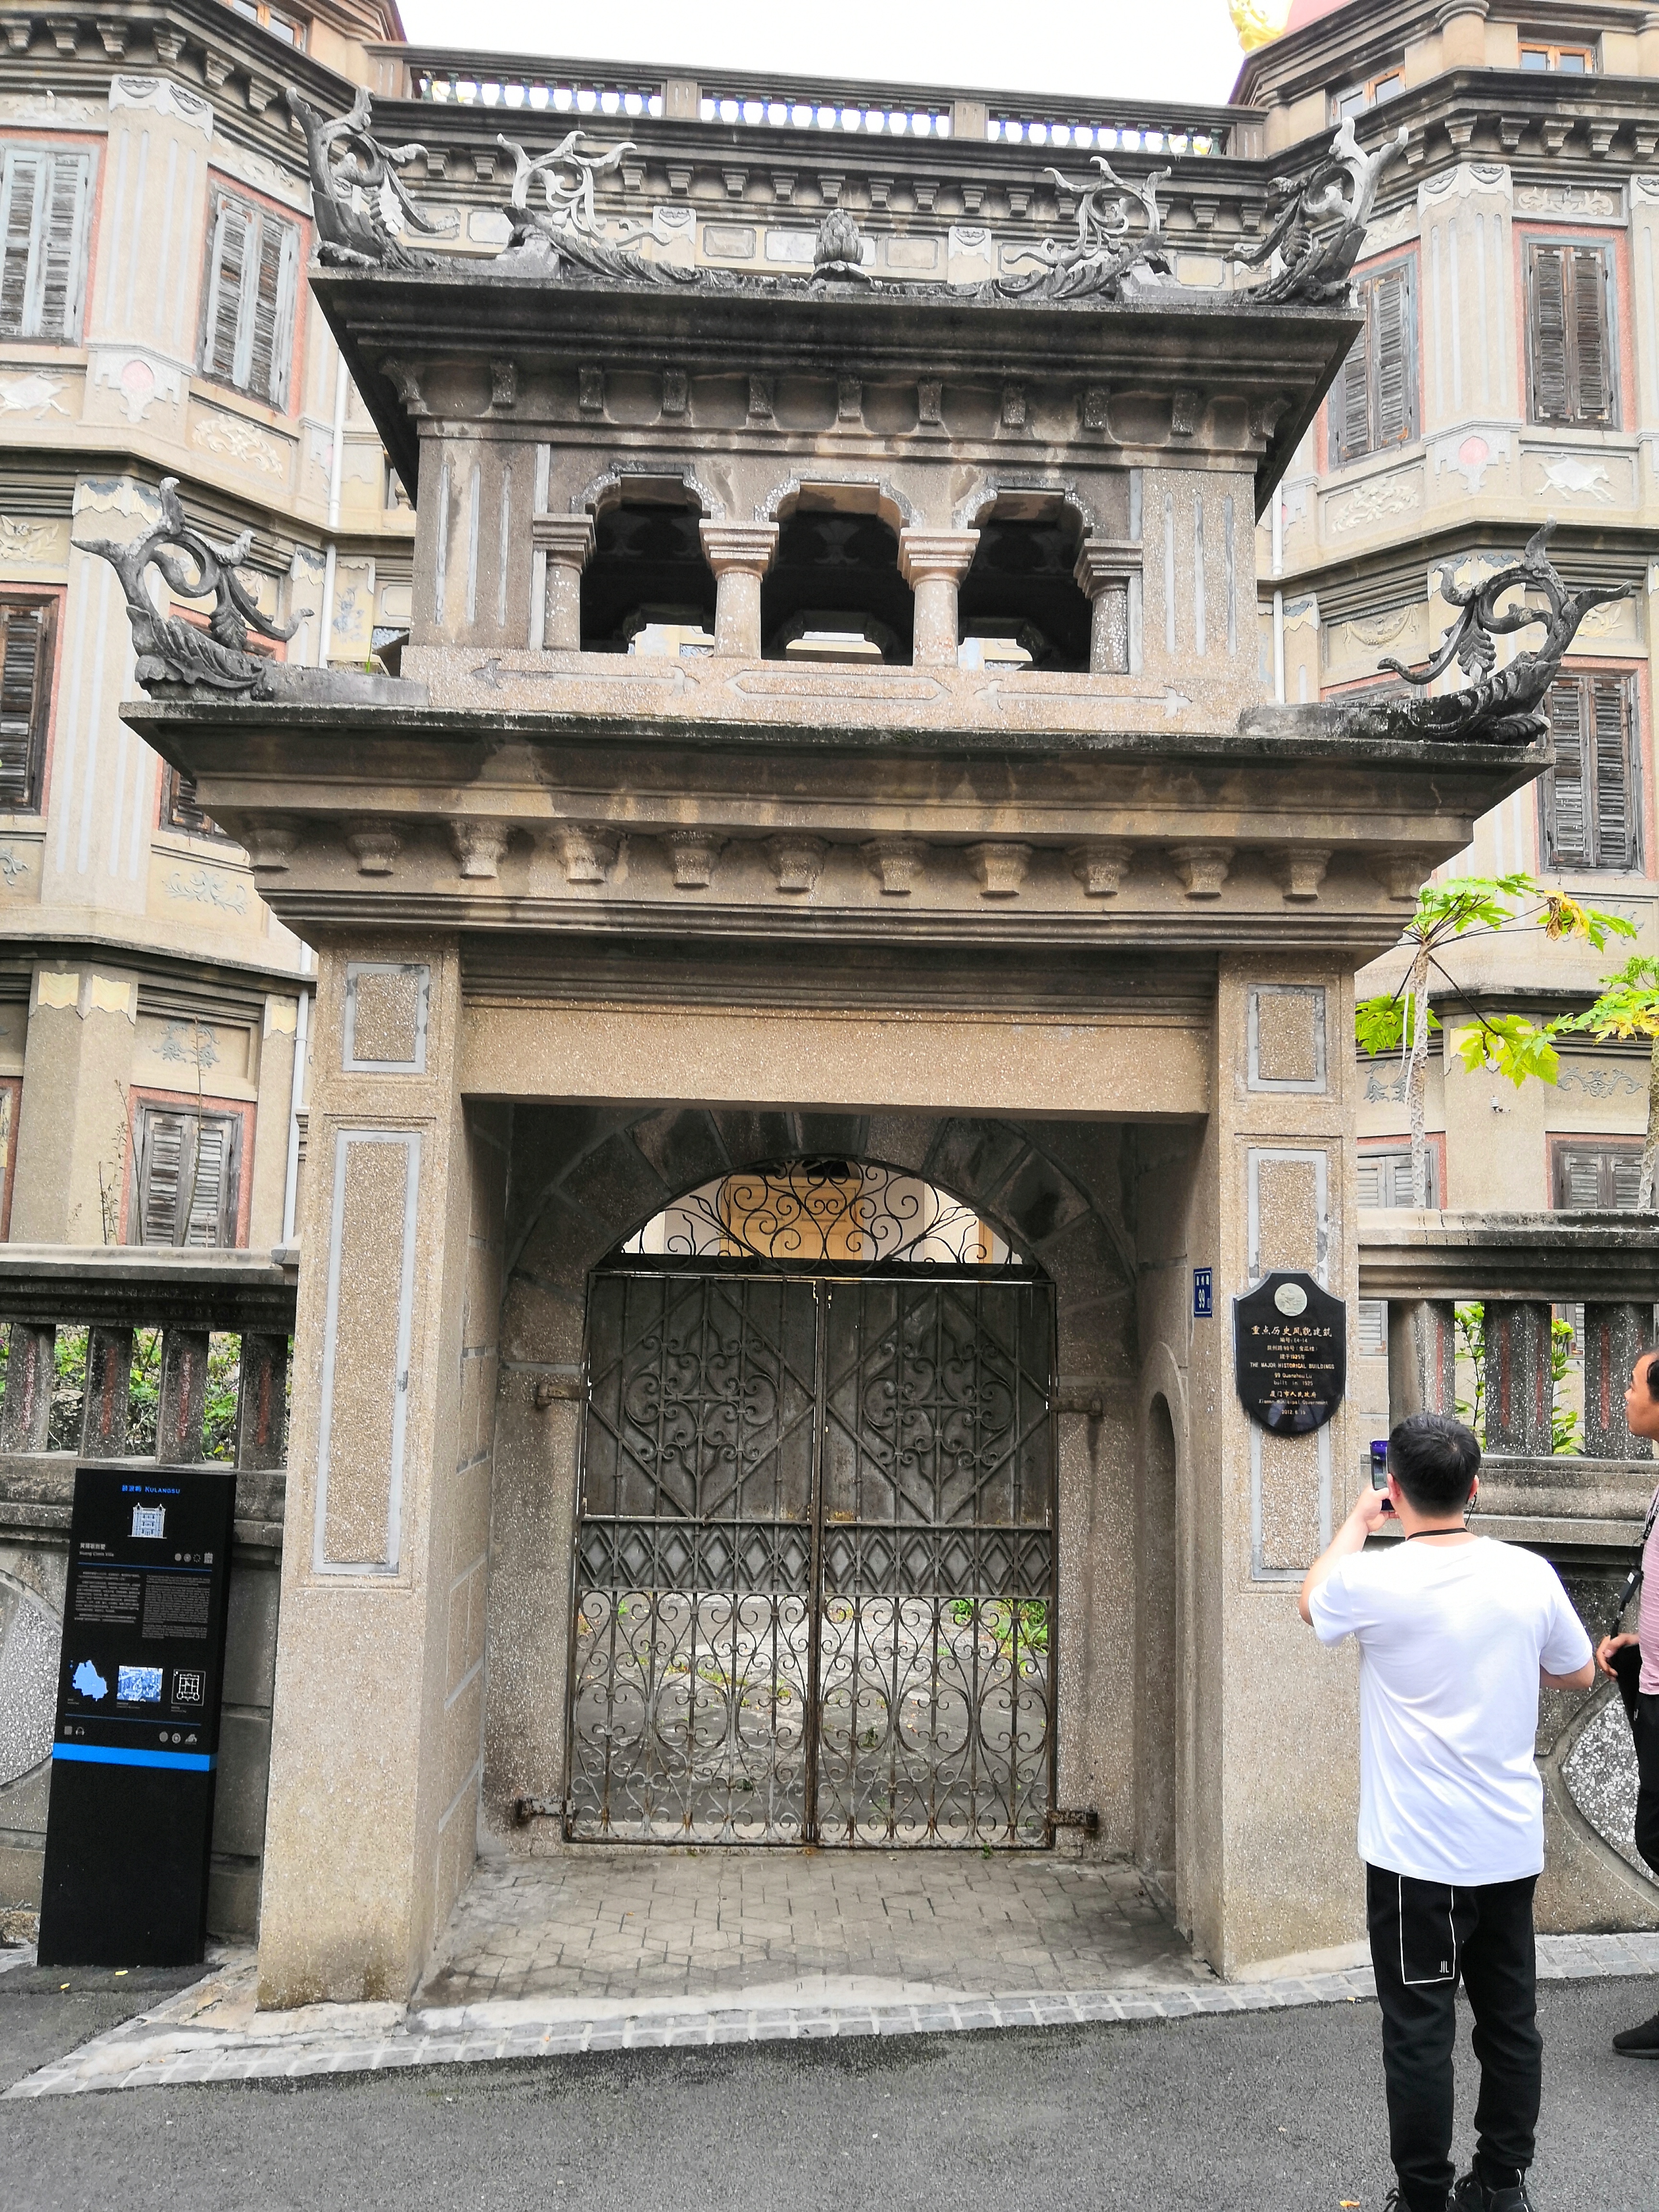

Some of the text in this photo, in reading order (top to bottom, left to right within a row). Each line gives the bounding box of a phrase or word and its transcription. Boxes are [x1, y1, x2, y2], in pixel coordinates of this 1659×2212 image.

[1199, 1289, 1205, 1308] 99
[1251, 1325, 1332, 1336] 重点历史风貌建筑
